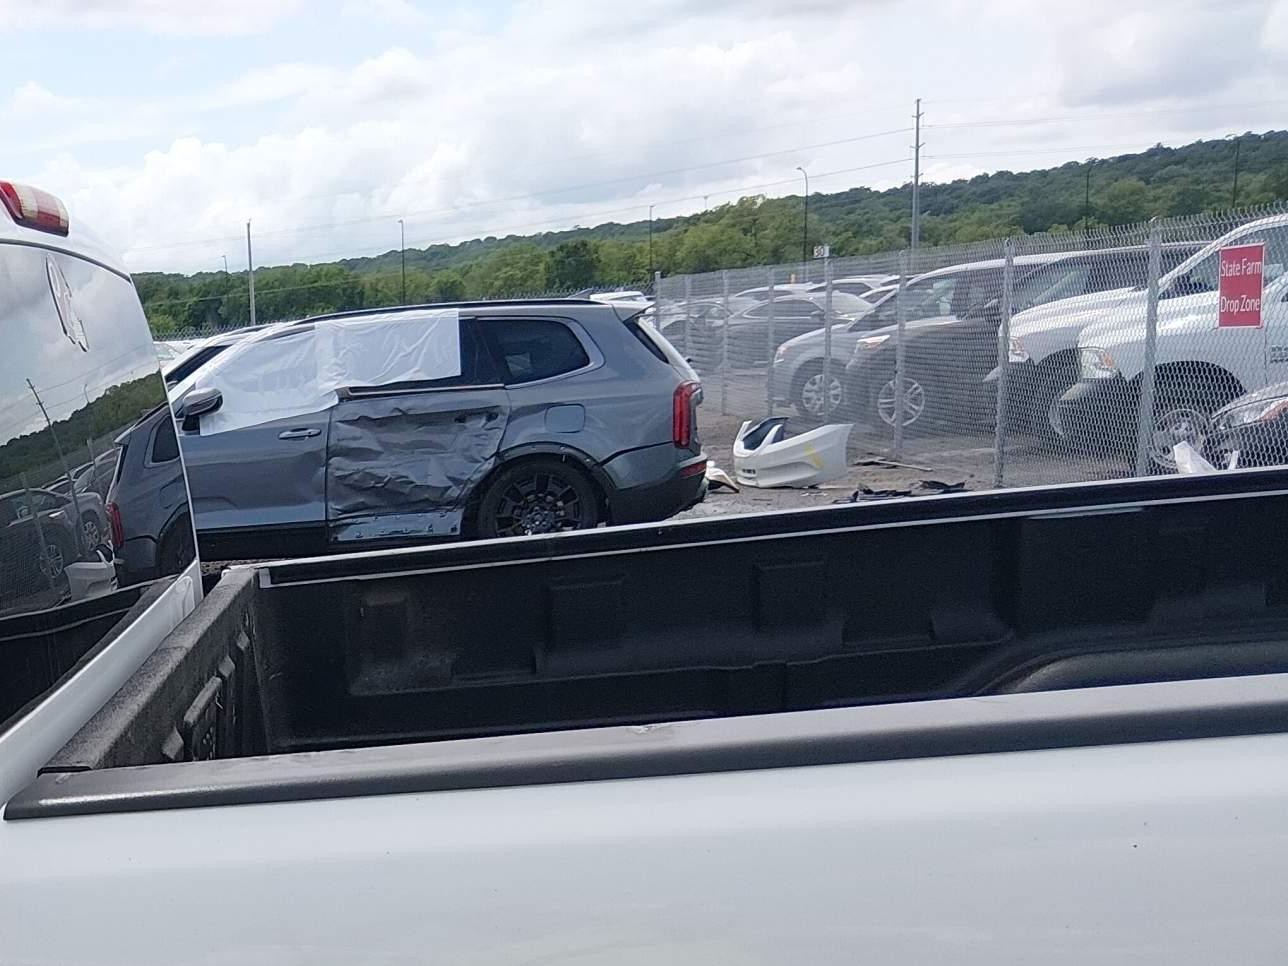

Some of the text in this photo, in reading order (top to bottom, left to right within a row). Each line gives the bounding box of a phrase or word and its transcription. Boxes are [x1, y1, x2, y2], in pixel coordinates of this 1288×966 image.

[1221, 258, 1261, 277] State Farm
[1220, 295, 1260, 315] Drop Zone
